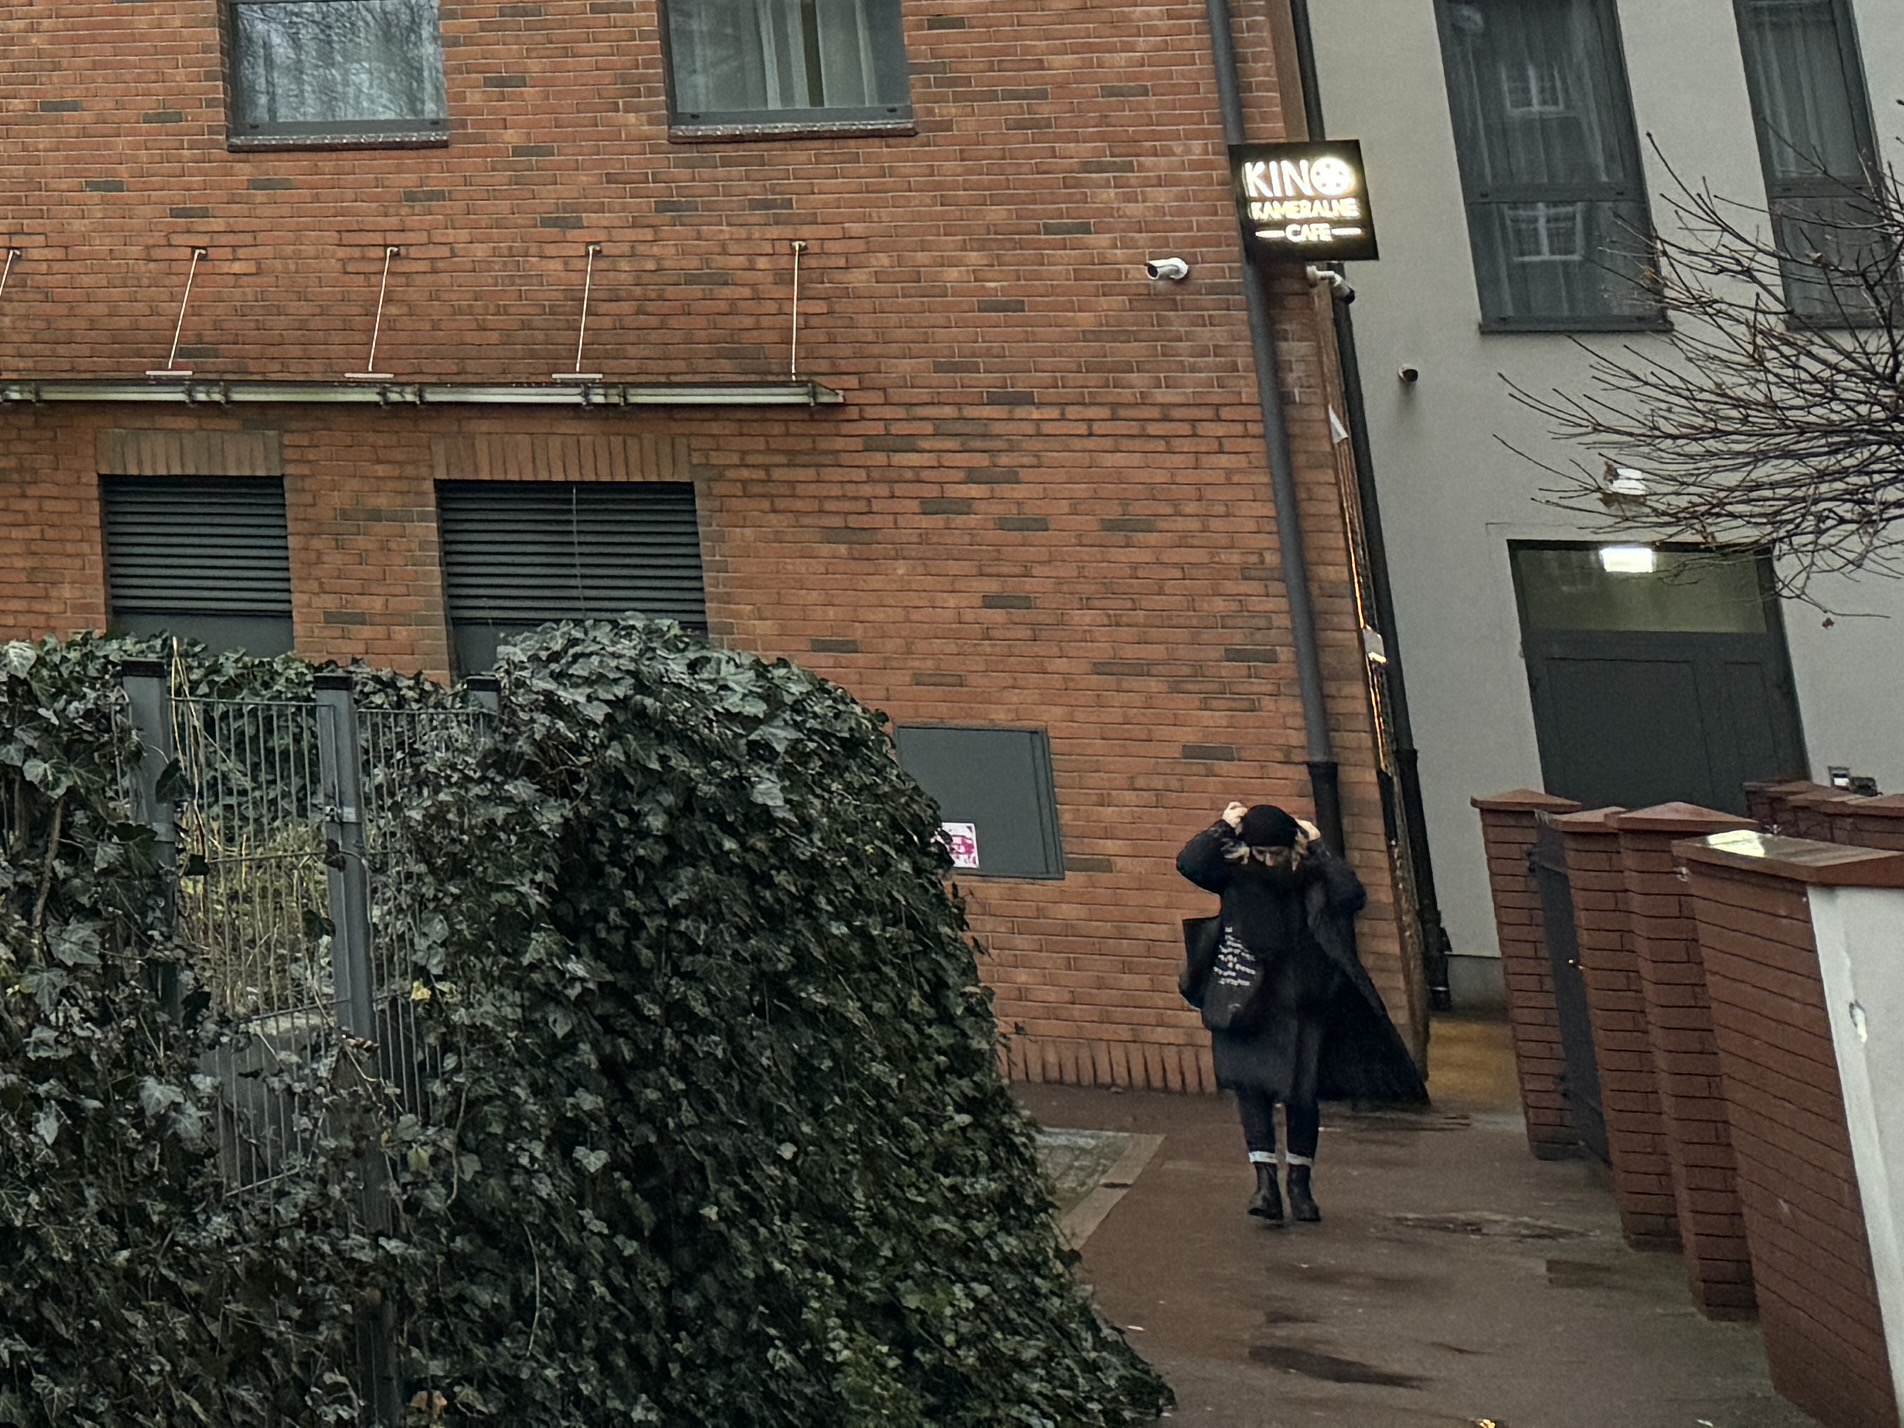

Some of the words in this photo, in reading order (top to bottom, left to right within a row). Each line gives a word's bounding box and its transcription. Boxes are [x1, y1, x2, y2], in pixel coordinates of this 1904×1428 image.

[1242, 156, 1353, 198] KINO
[1249, 198, 1360, 221] KAMERALNE
[1285, 223, 1333, 243] CAFE
